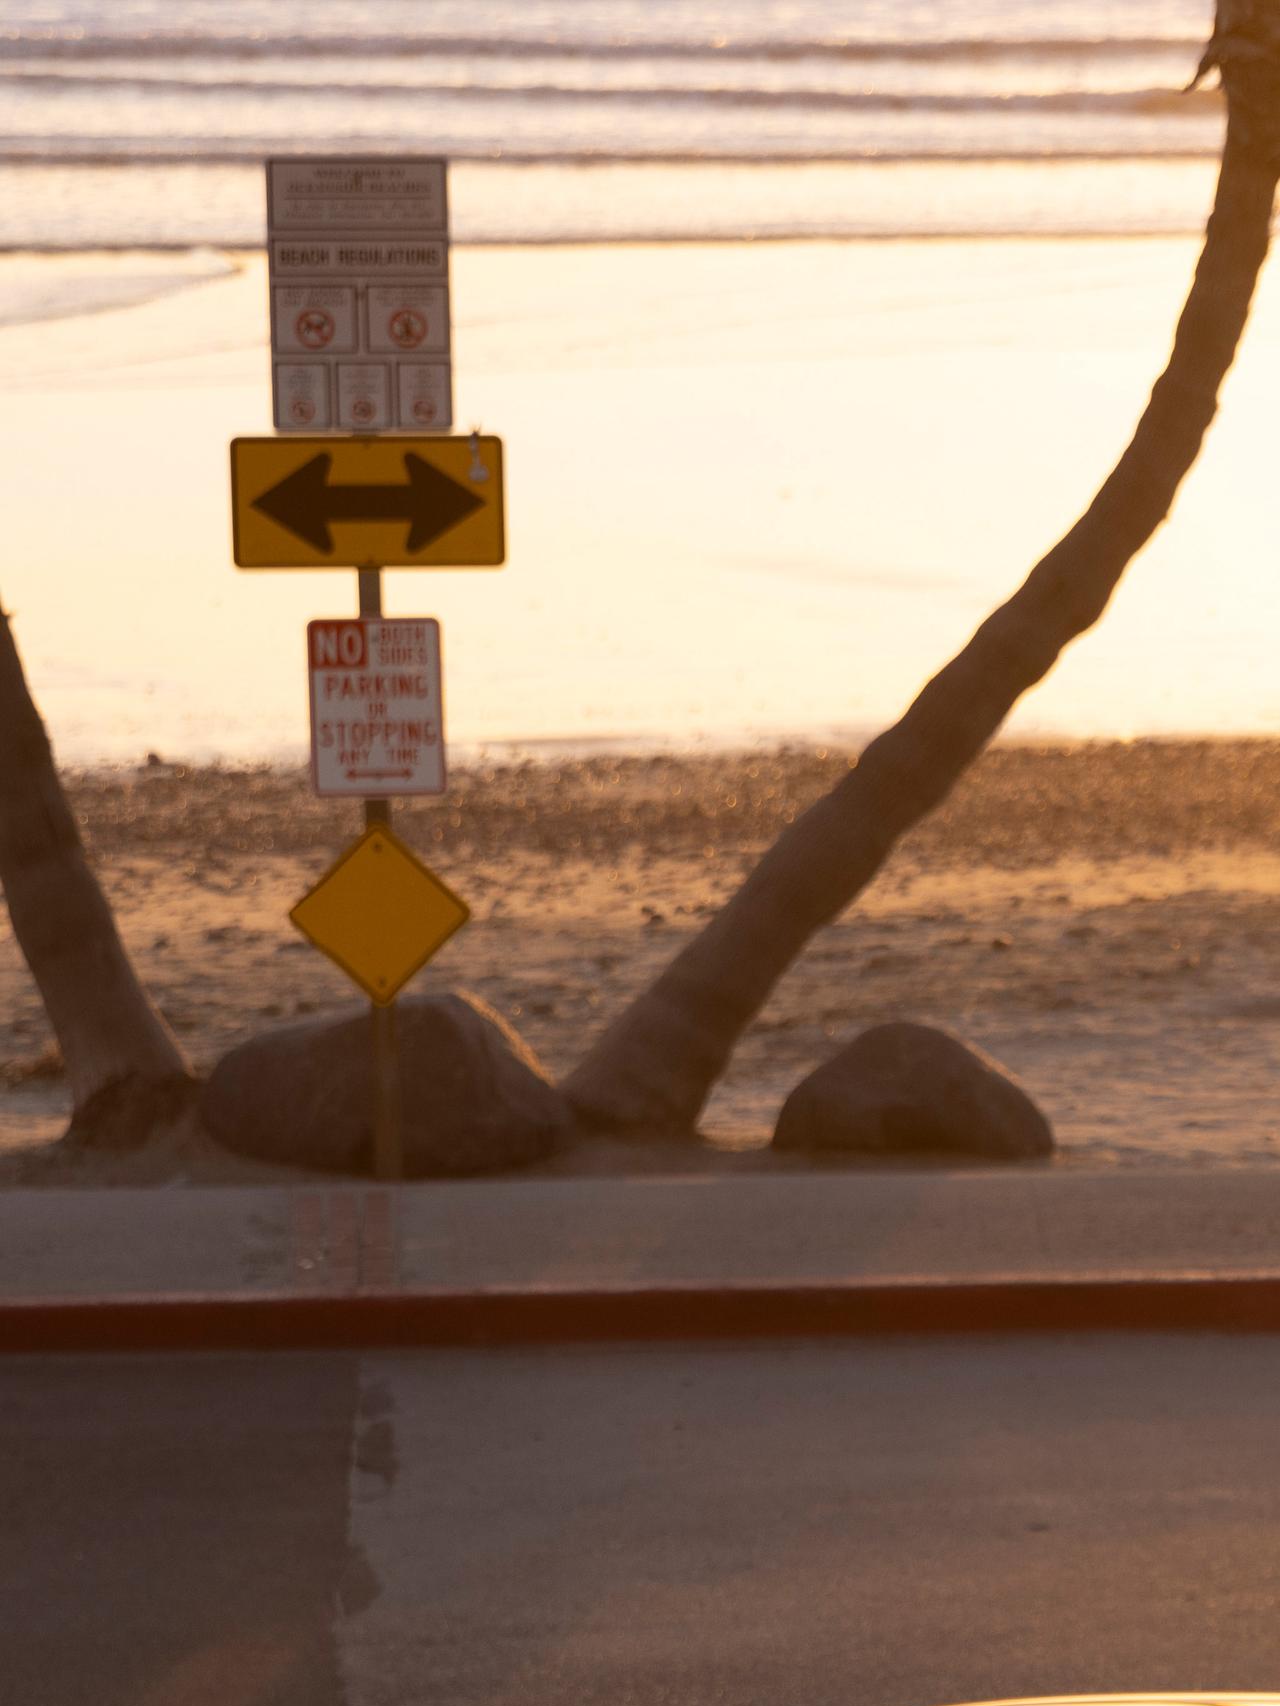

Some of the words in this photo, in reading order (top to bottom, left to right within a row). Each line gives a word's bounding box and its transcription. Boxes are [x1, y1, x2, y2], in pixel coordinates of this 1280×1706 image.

[279, 247, 330, 266] BEACH
[338, 248, 438, 266] REGULATIONS
[313, 625, 363, 666] NO
[380, 626, 426, 646] BOTH
[378, 647, 428, 666] SIDES
[325, 674, 429, 700] PARKING
[318, 720, 437, 748] STOPPING
[338, 749, 371, 766] ANY
[388, 749, 421, 764] TIME
